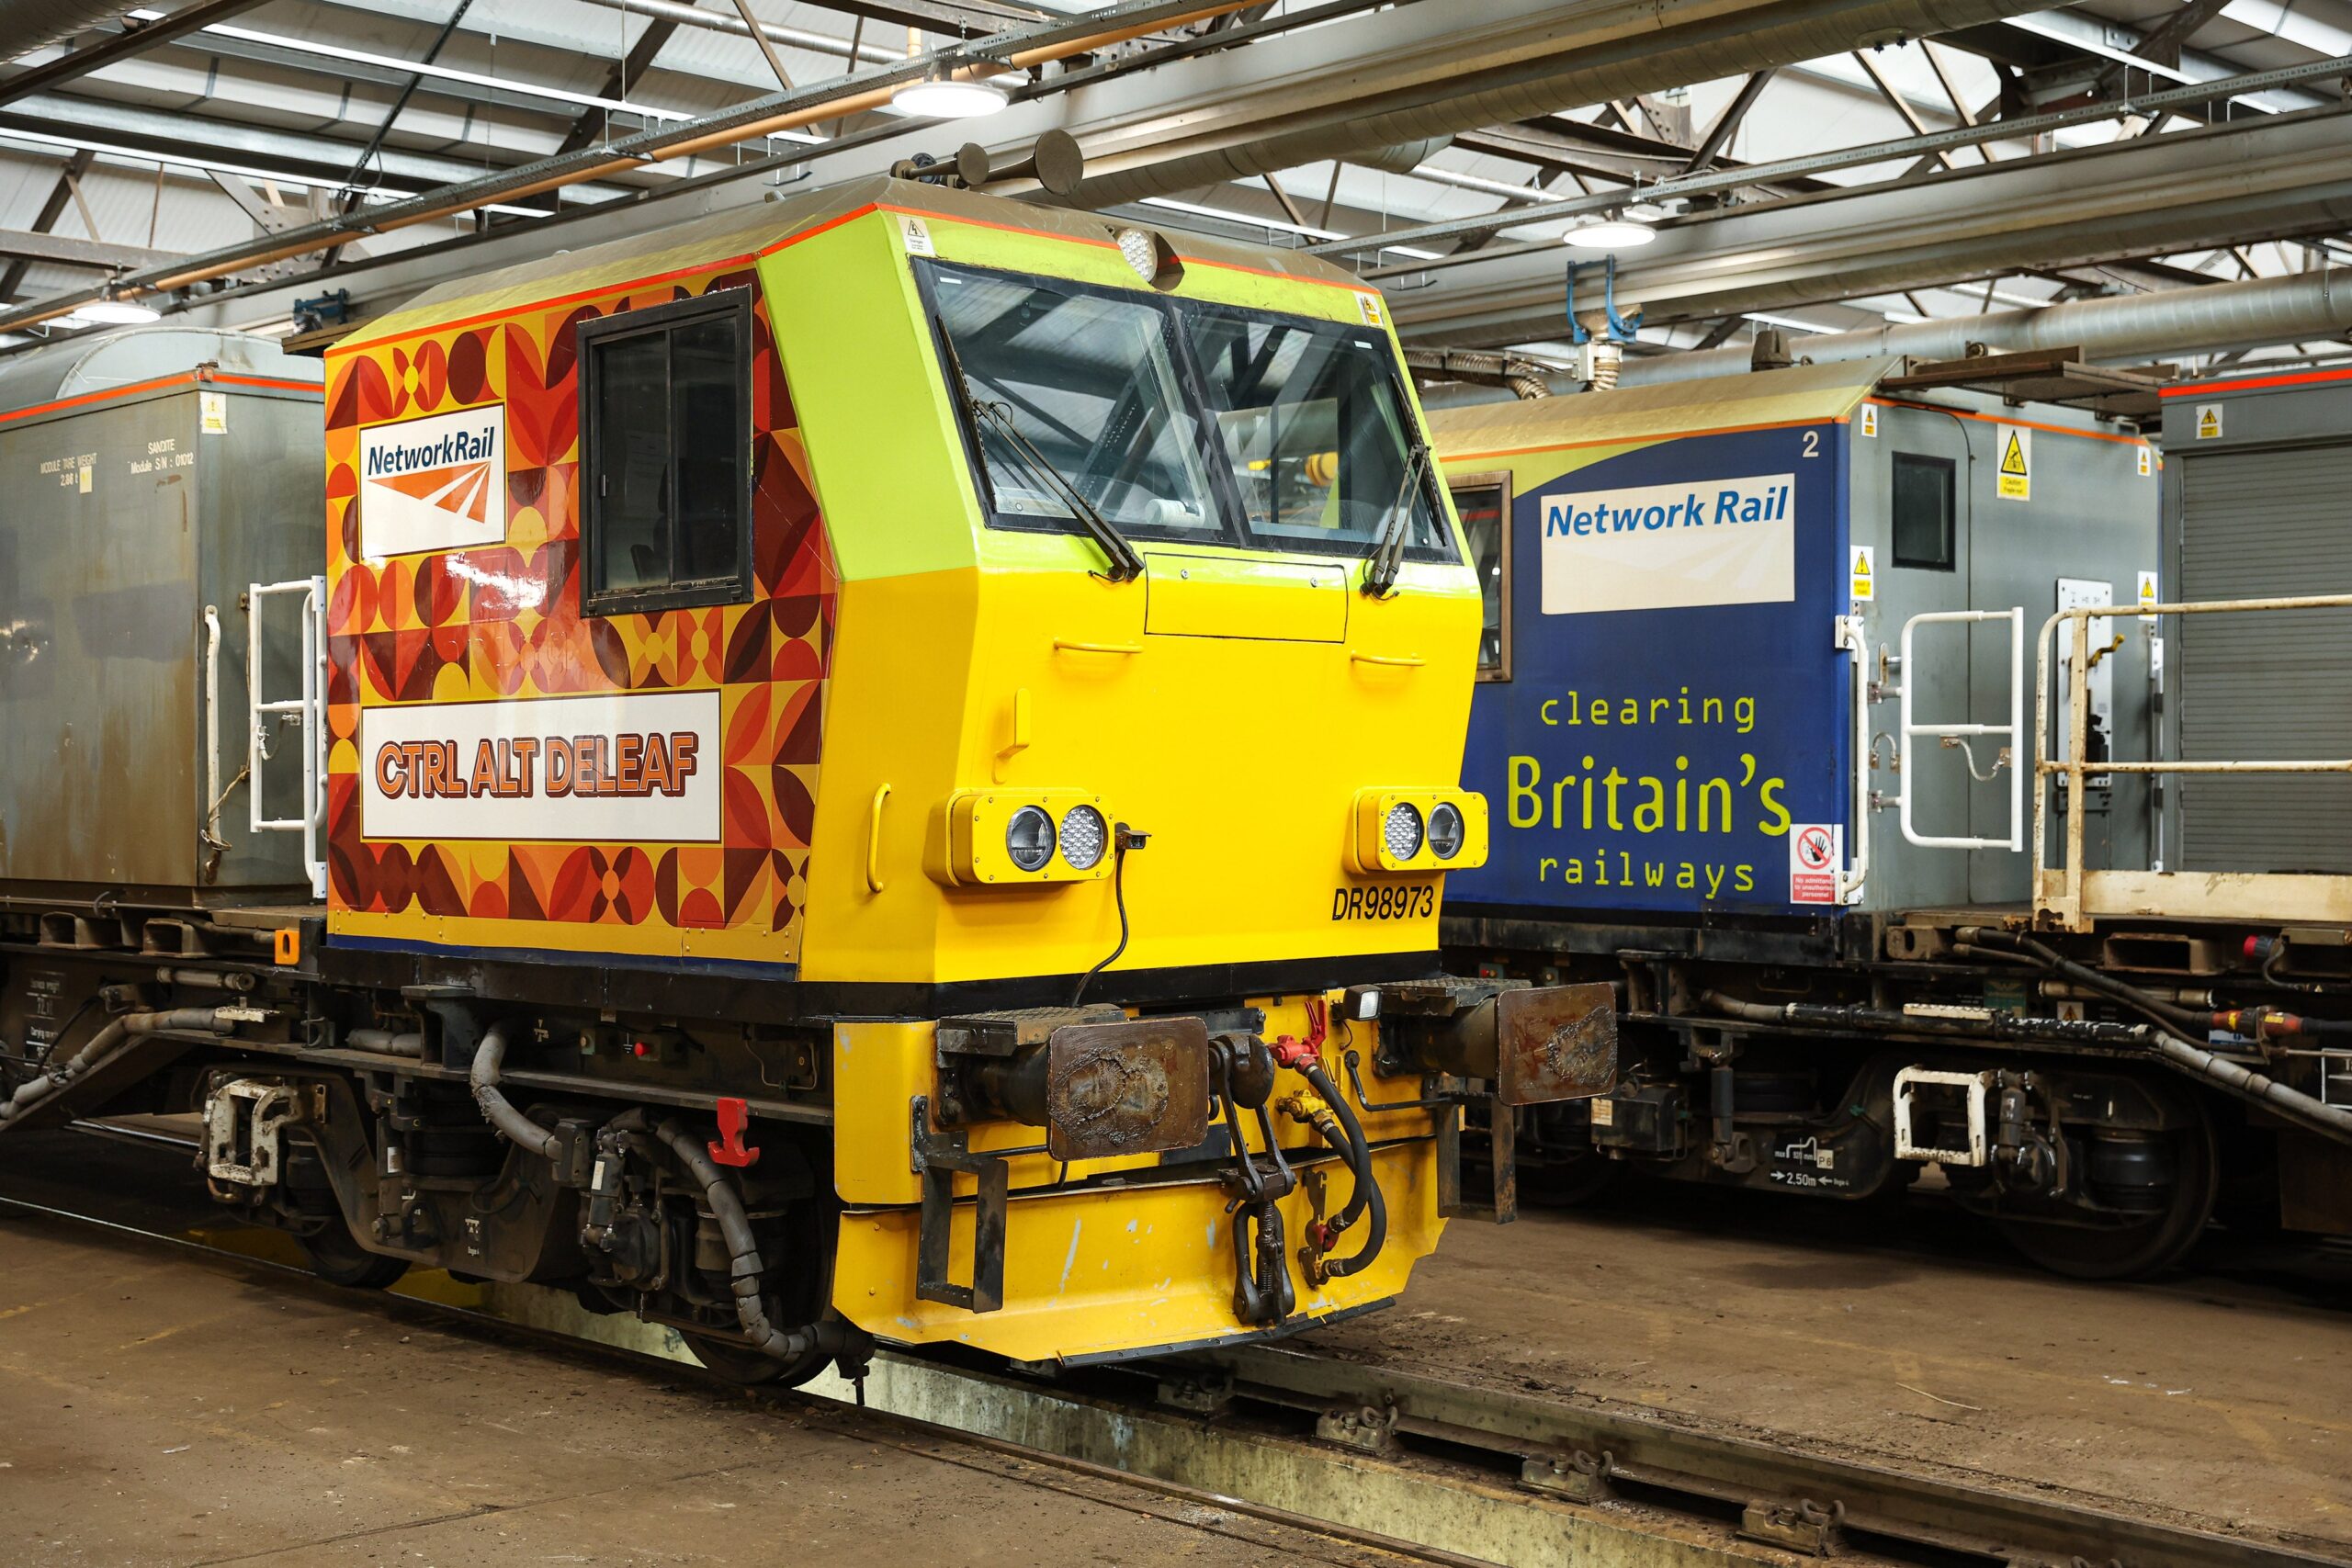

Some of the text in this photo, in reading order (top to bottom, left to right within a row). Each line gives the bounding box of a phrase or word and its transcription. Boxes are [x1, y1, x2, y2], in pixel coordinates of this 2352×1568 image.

[148, 438, 175, 455] SANDITE
[1802, 430, 1819, 458] 2
[130, 459, 153, 475] Module
[1546, 486, 1789, 537] Network Rail
[1540, 686, 1755, 733] clearing
[376, 731, 699, 799] CTRL ALT DELEAF
[1540, 849, 1754, 900] railways
[1332, 885, 1434, 920] DR98973
